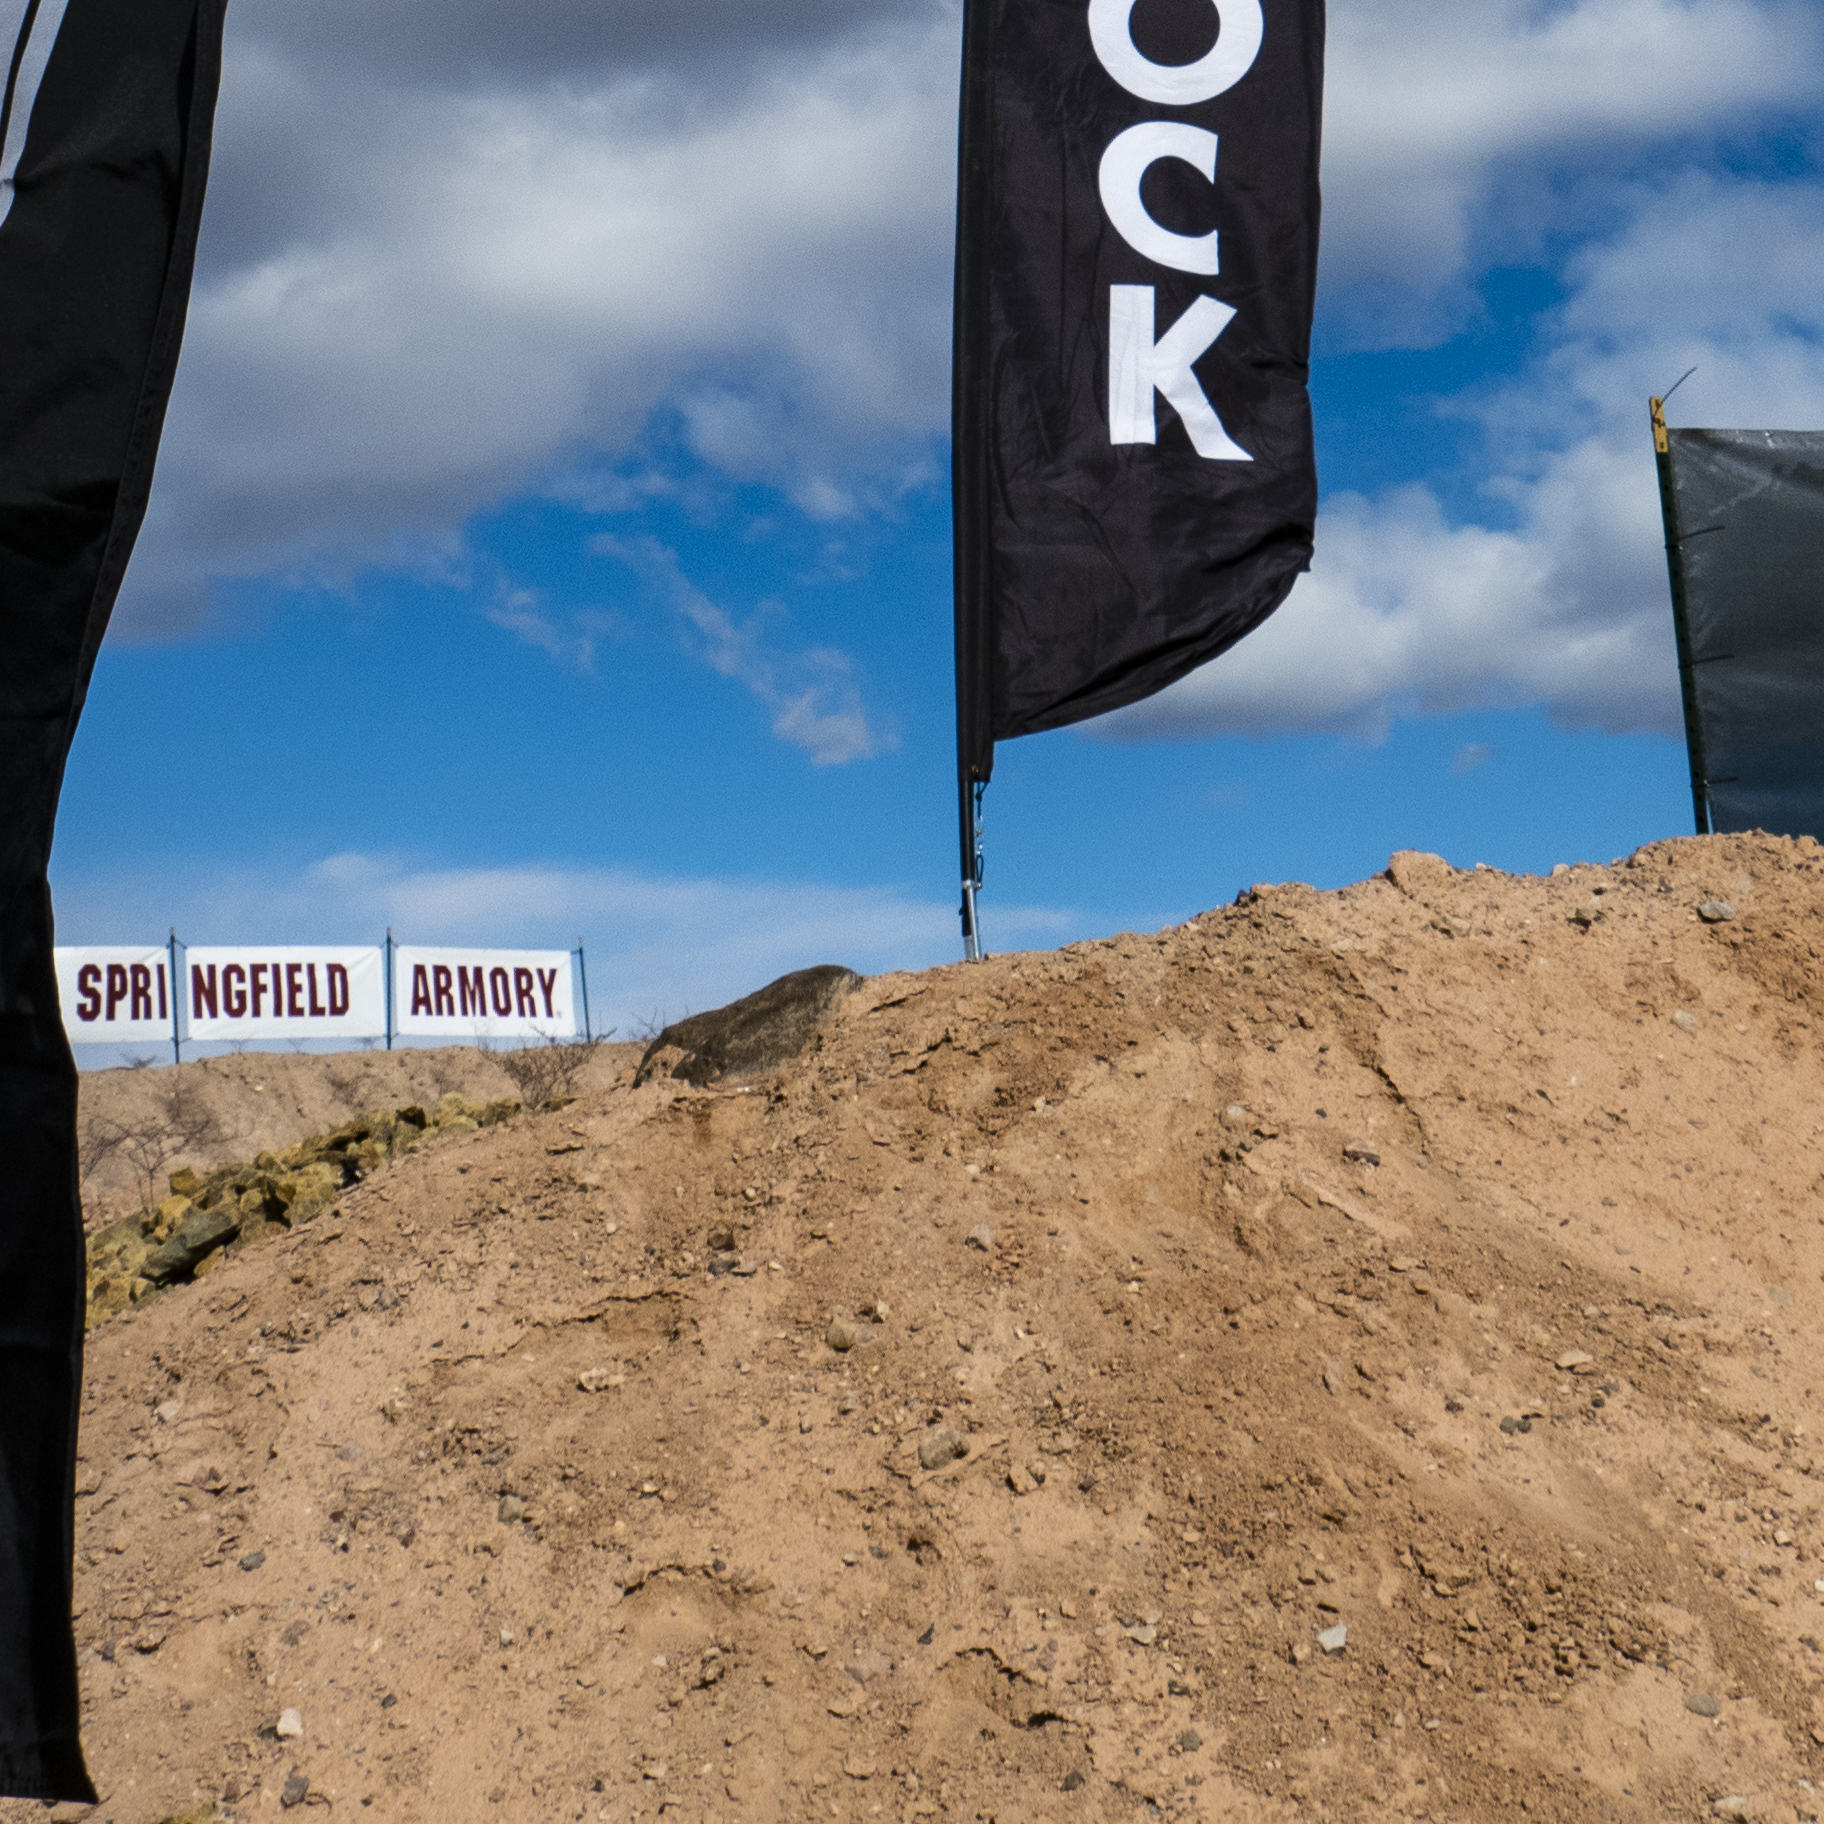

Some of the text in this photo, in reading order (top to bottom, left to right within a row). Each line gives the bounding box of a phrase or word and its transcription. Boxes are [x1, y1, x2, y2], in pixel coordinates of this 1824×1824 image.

[77, 962, 558, 1022] SPRI NGFIELD ARMORY
